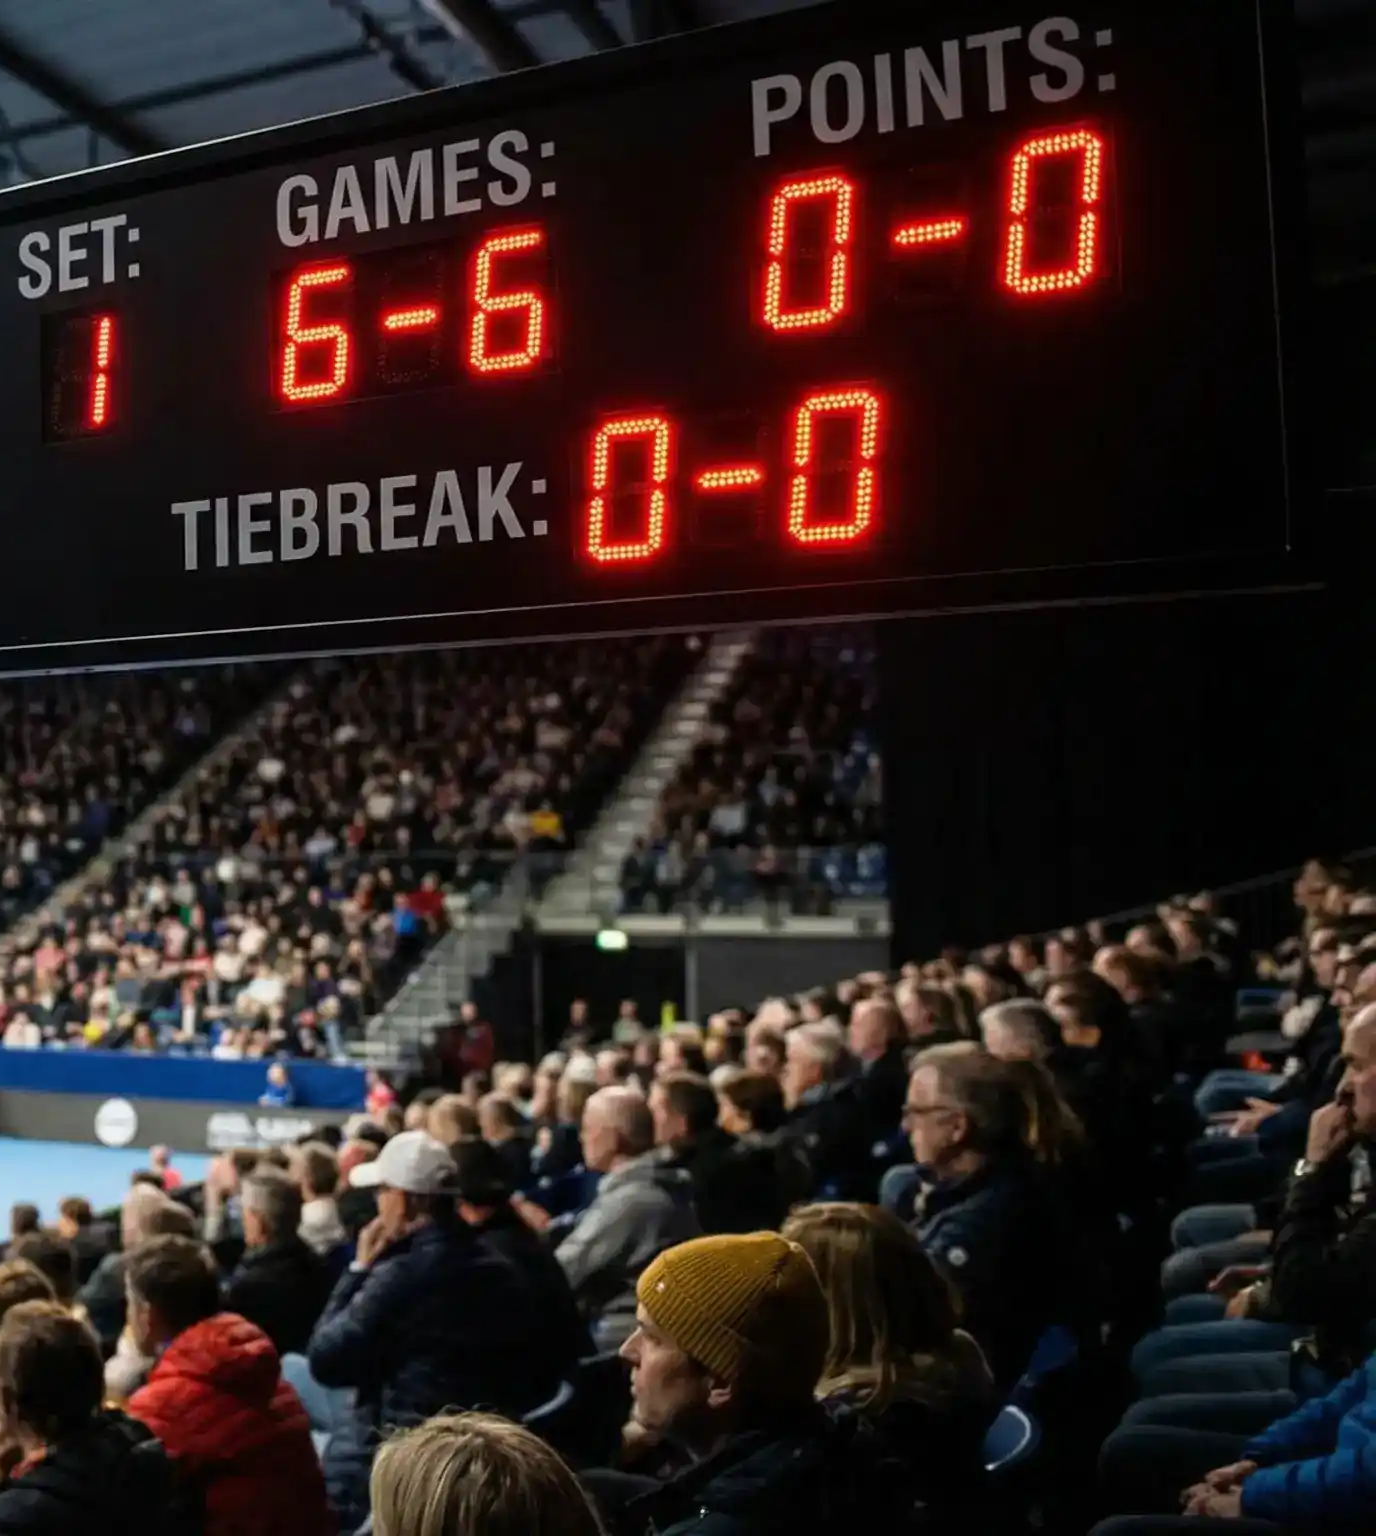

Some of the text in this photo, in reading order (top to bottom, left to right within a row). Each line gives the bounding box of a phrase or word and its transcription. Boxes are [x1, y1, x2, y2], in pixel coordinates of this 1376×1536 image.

[751, 16, 1116, 157] POINTS:
[276, 130, 556, 248] GAMES:
[18, 214, 140, 300] SET:
[91, 317, 112, 425] 1
[171, 462, 548, 571] TIEBREAK:
